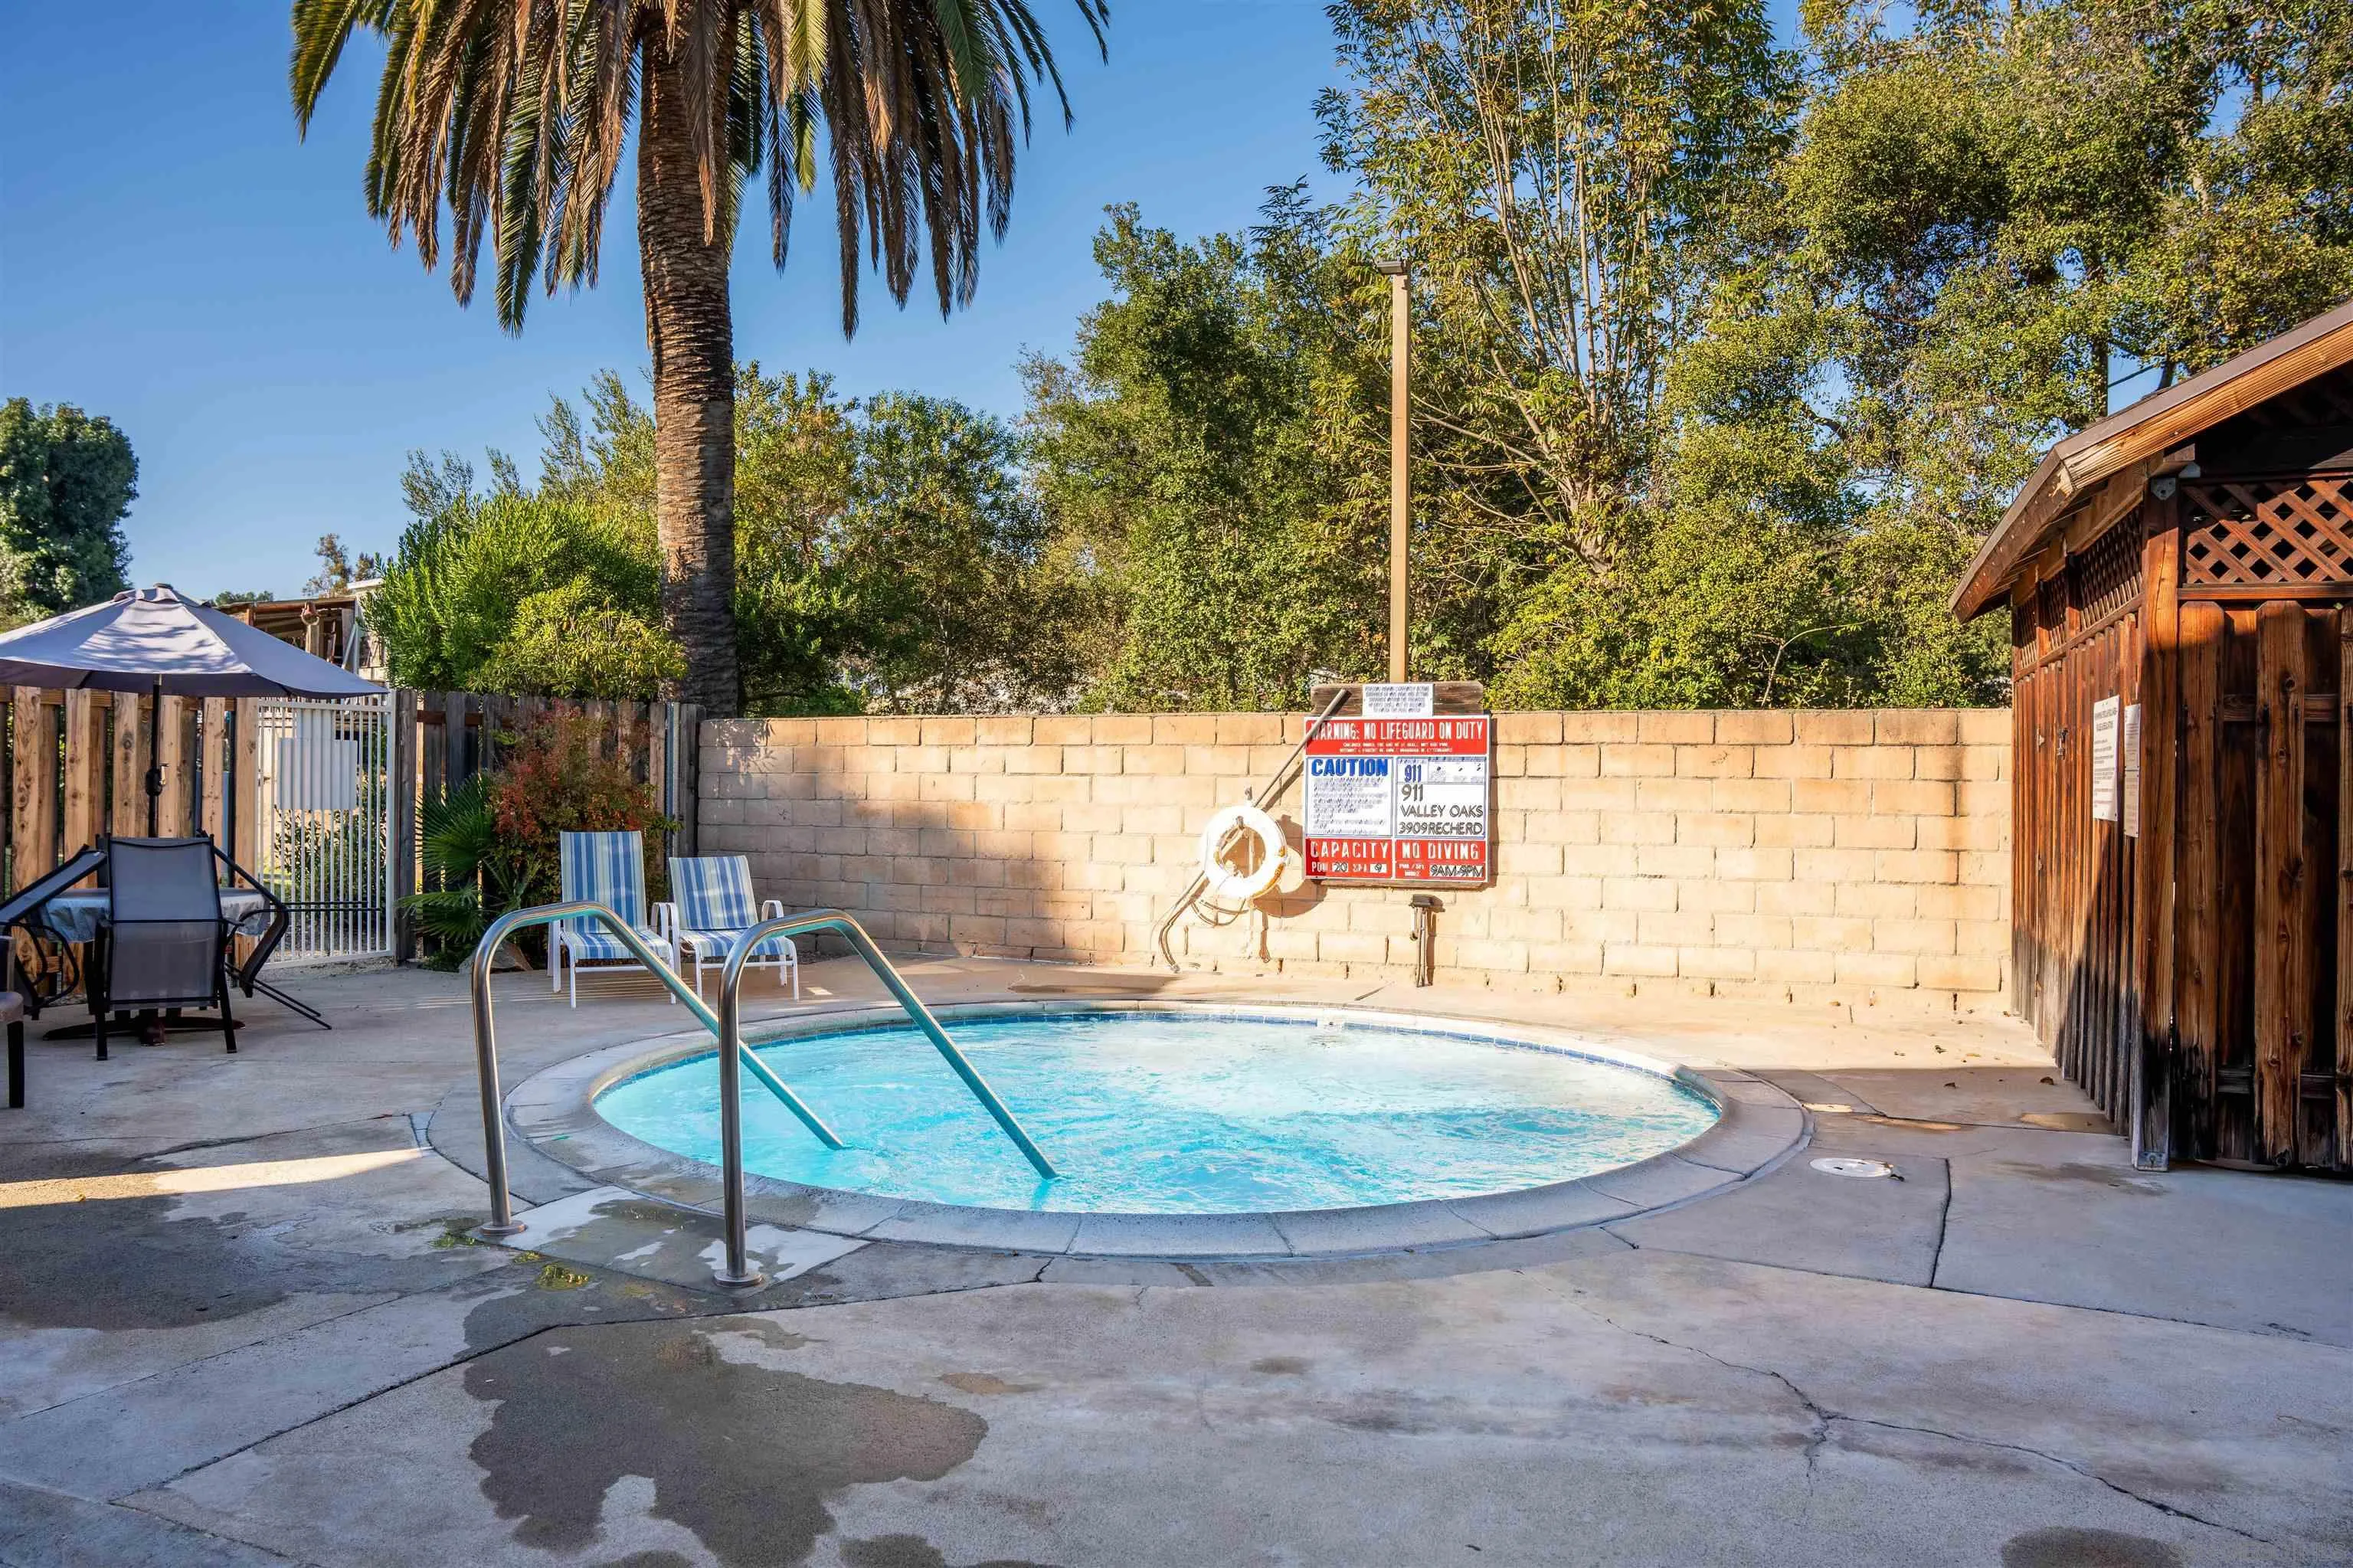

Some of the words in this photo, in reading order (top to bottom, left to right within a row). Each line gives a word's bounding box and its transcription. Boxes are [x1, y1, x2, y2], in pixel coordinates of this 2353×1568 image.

[1363, 722, 1376, 741] NO
[1380, 722, 1435, 741] LIFEGUARD
[1439, 722, 1452, 740] ON
[1456, 722, 1483, 740] DUTY
[1311, 758, 1388, 777] CAUTION
[1404, 764, 1422, 782] 911
[1401, 784, 1423, 801] 911
[1400, 804, 1445, 817] VALLEY
[1449, 804, 1484, 818] OAKS
[1311, 841, 1388, 858] CAPACITY
[1402, 842, 1420, 859] NO
[1427, 842, 1479, 859] DIVING
[1334, 862, 1348, 872] 20
[1374, 863, 1383, 872] 9
